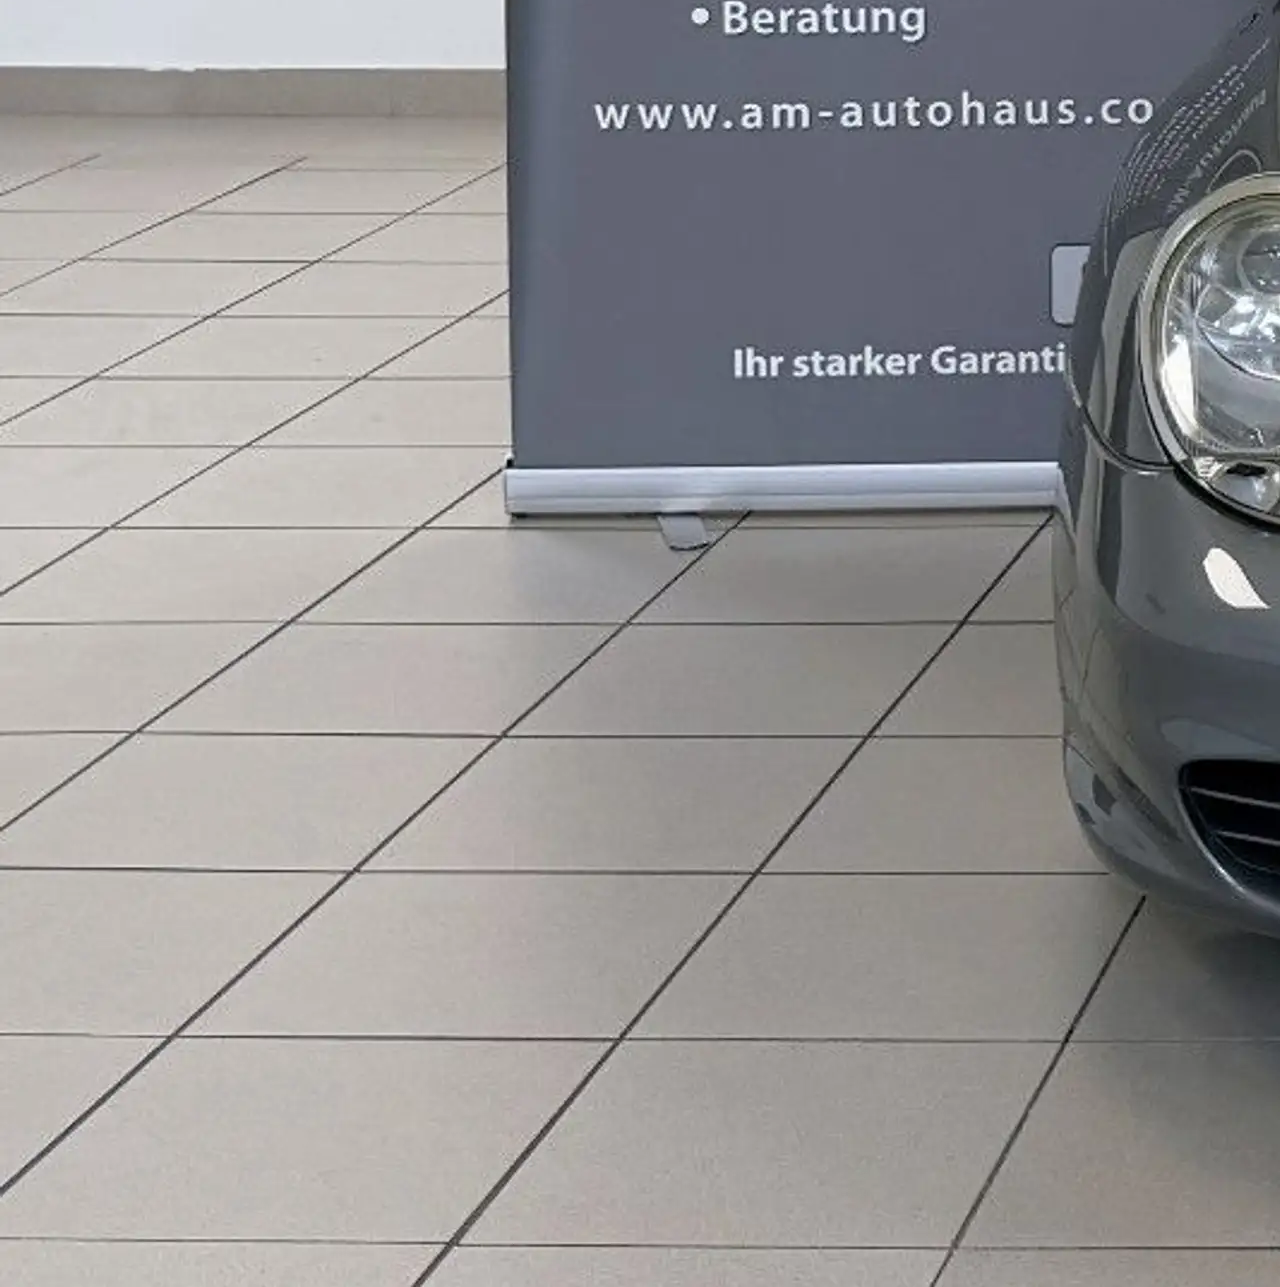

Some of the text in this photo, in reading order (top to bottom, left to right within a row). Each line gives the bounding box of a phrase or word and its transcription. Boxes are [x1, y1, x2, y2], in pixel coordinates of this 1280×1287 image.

[722, 0, 927, 42] Beratung
[593, 90, 1154, 131] www.am-autohaus.co
[733, 342, 1066, 379] Ihr starker Garanti
